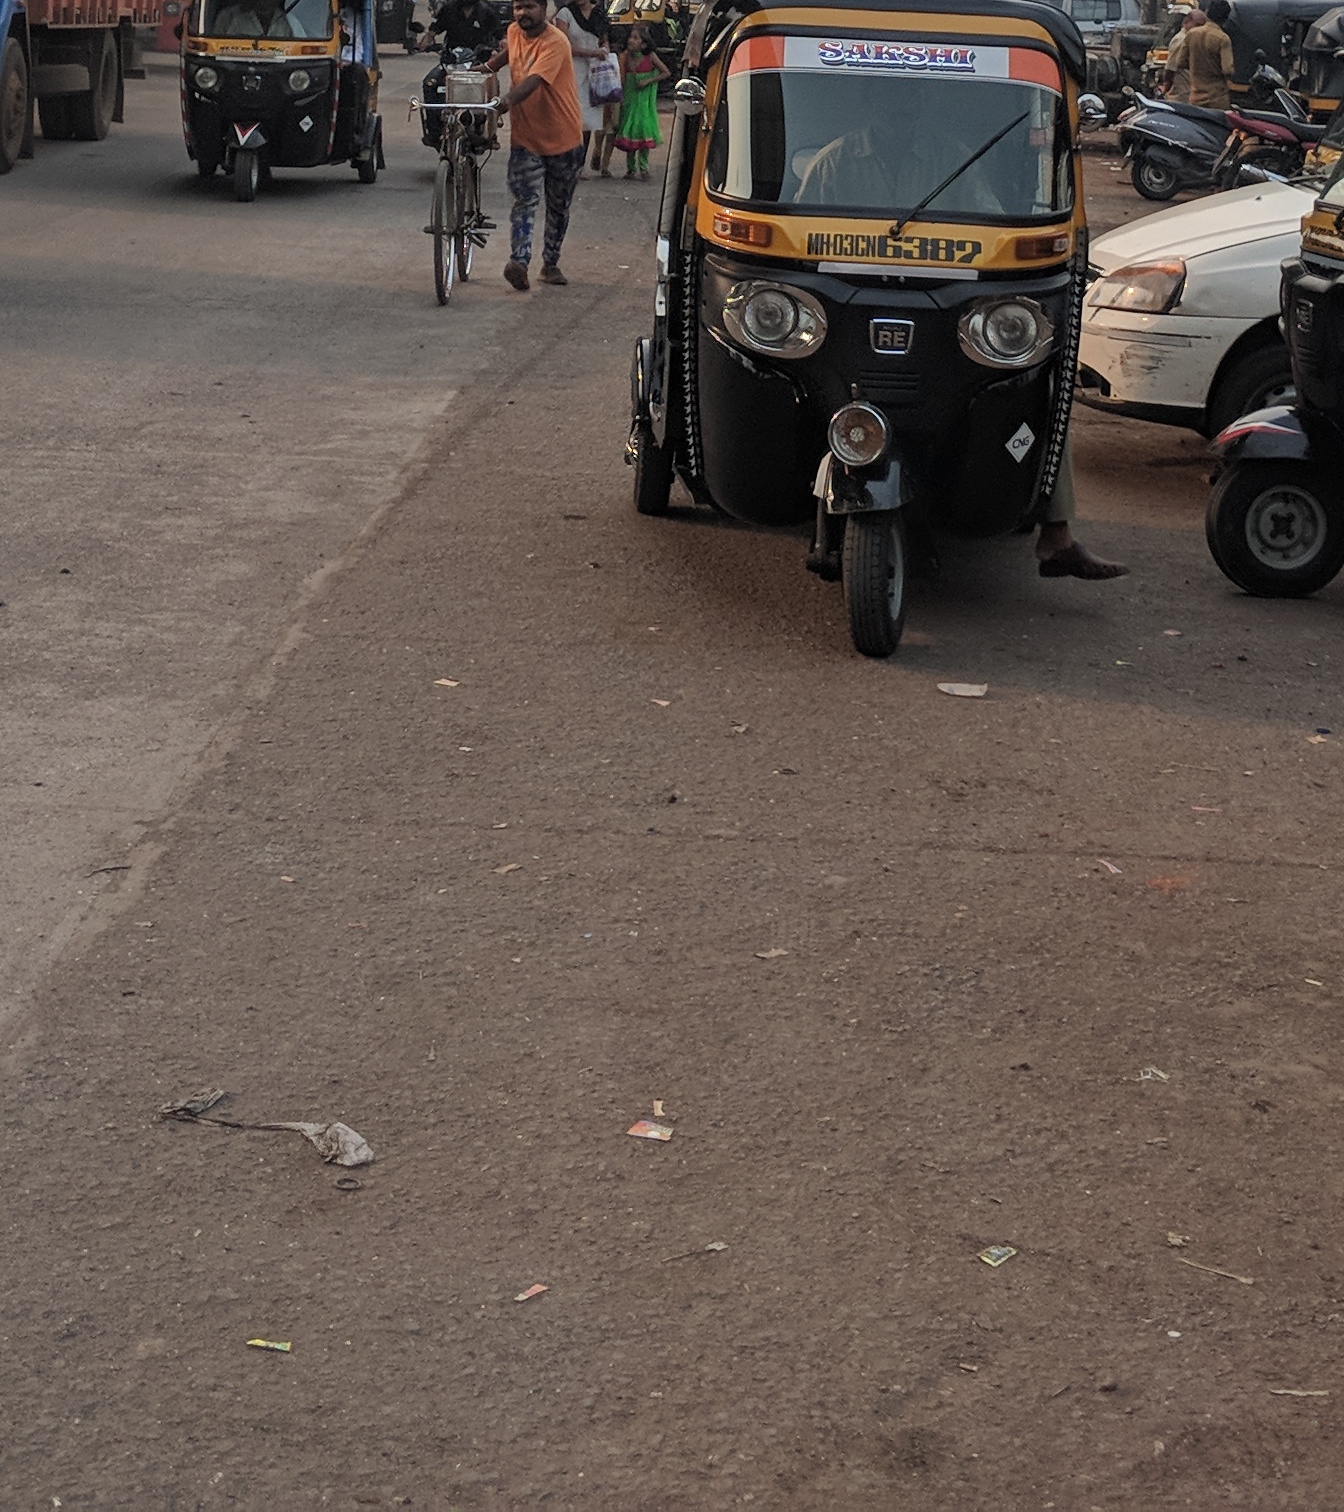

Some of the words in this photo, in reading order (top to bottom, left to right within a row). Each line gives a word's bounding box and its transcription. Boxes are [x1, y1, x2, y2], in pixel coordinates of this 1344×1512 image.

[818, 41, 976, 73] SAKSHI
[878, 330, 906, 347] RE
[1012, 436, 1030, 449] CNG
